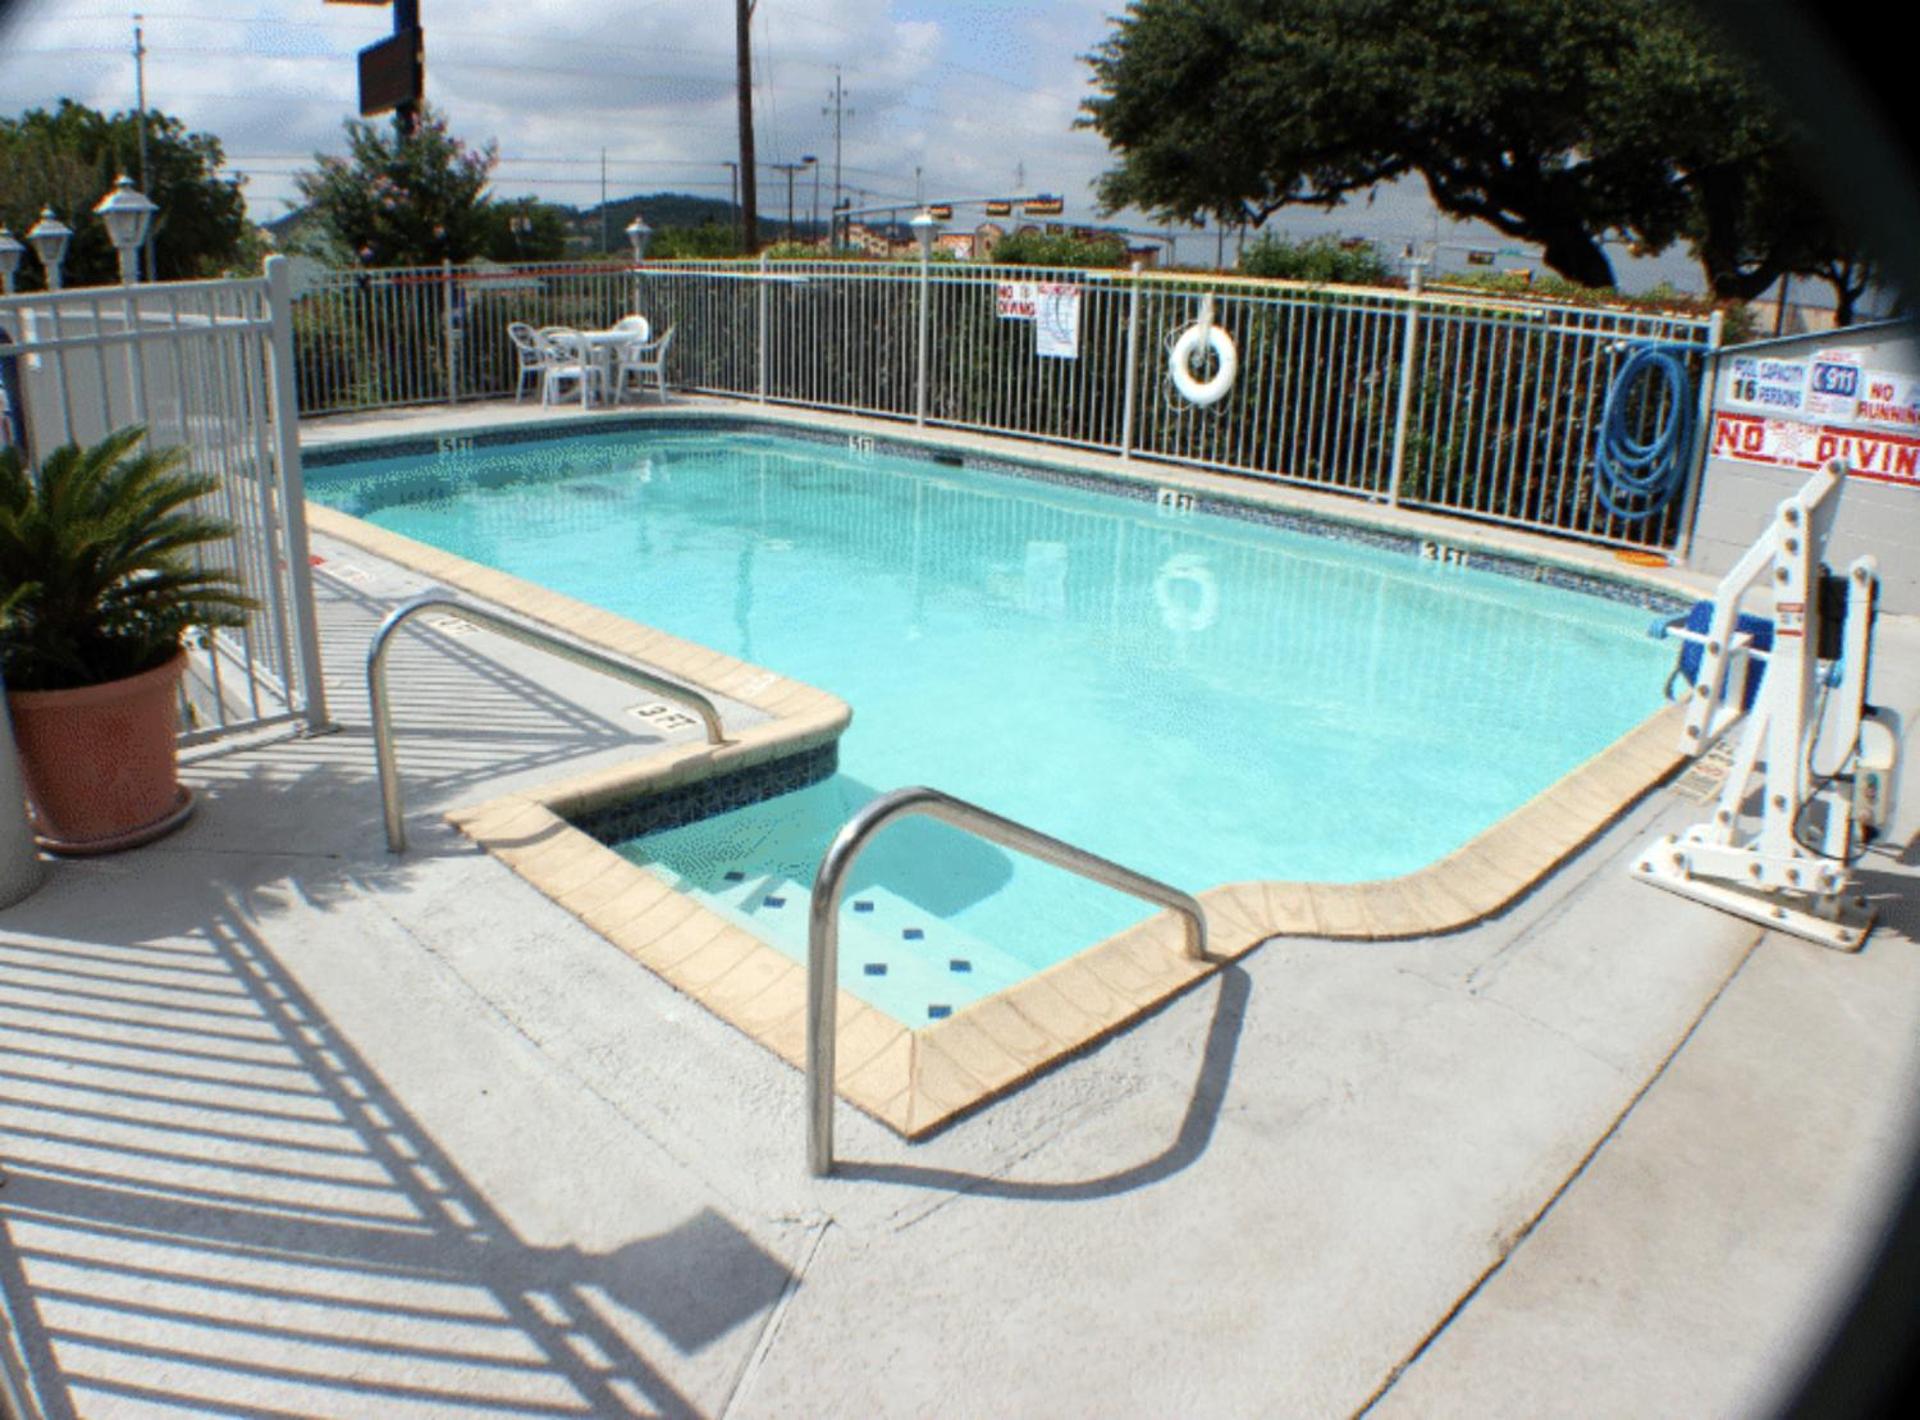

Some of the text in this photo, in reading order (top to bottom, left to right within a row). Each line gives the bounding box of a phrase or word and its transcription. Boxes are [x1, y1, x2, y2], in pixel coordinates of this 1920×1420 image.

[998, 285, 1014, 299] NO
[1734, 378, 1756, 402] 16
[1826, 366, 1856, 394] 911
[1870, 382, 1893, 401] NO
[1716, 420, 1764, 451] NO
[1424, 541, 1438, 560] 3
[637, 705, 697, 730] 3 FT
